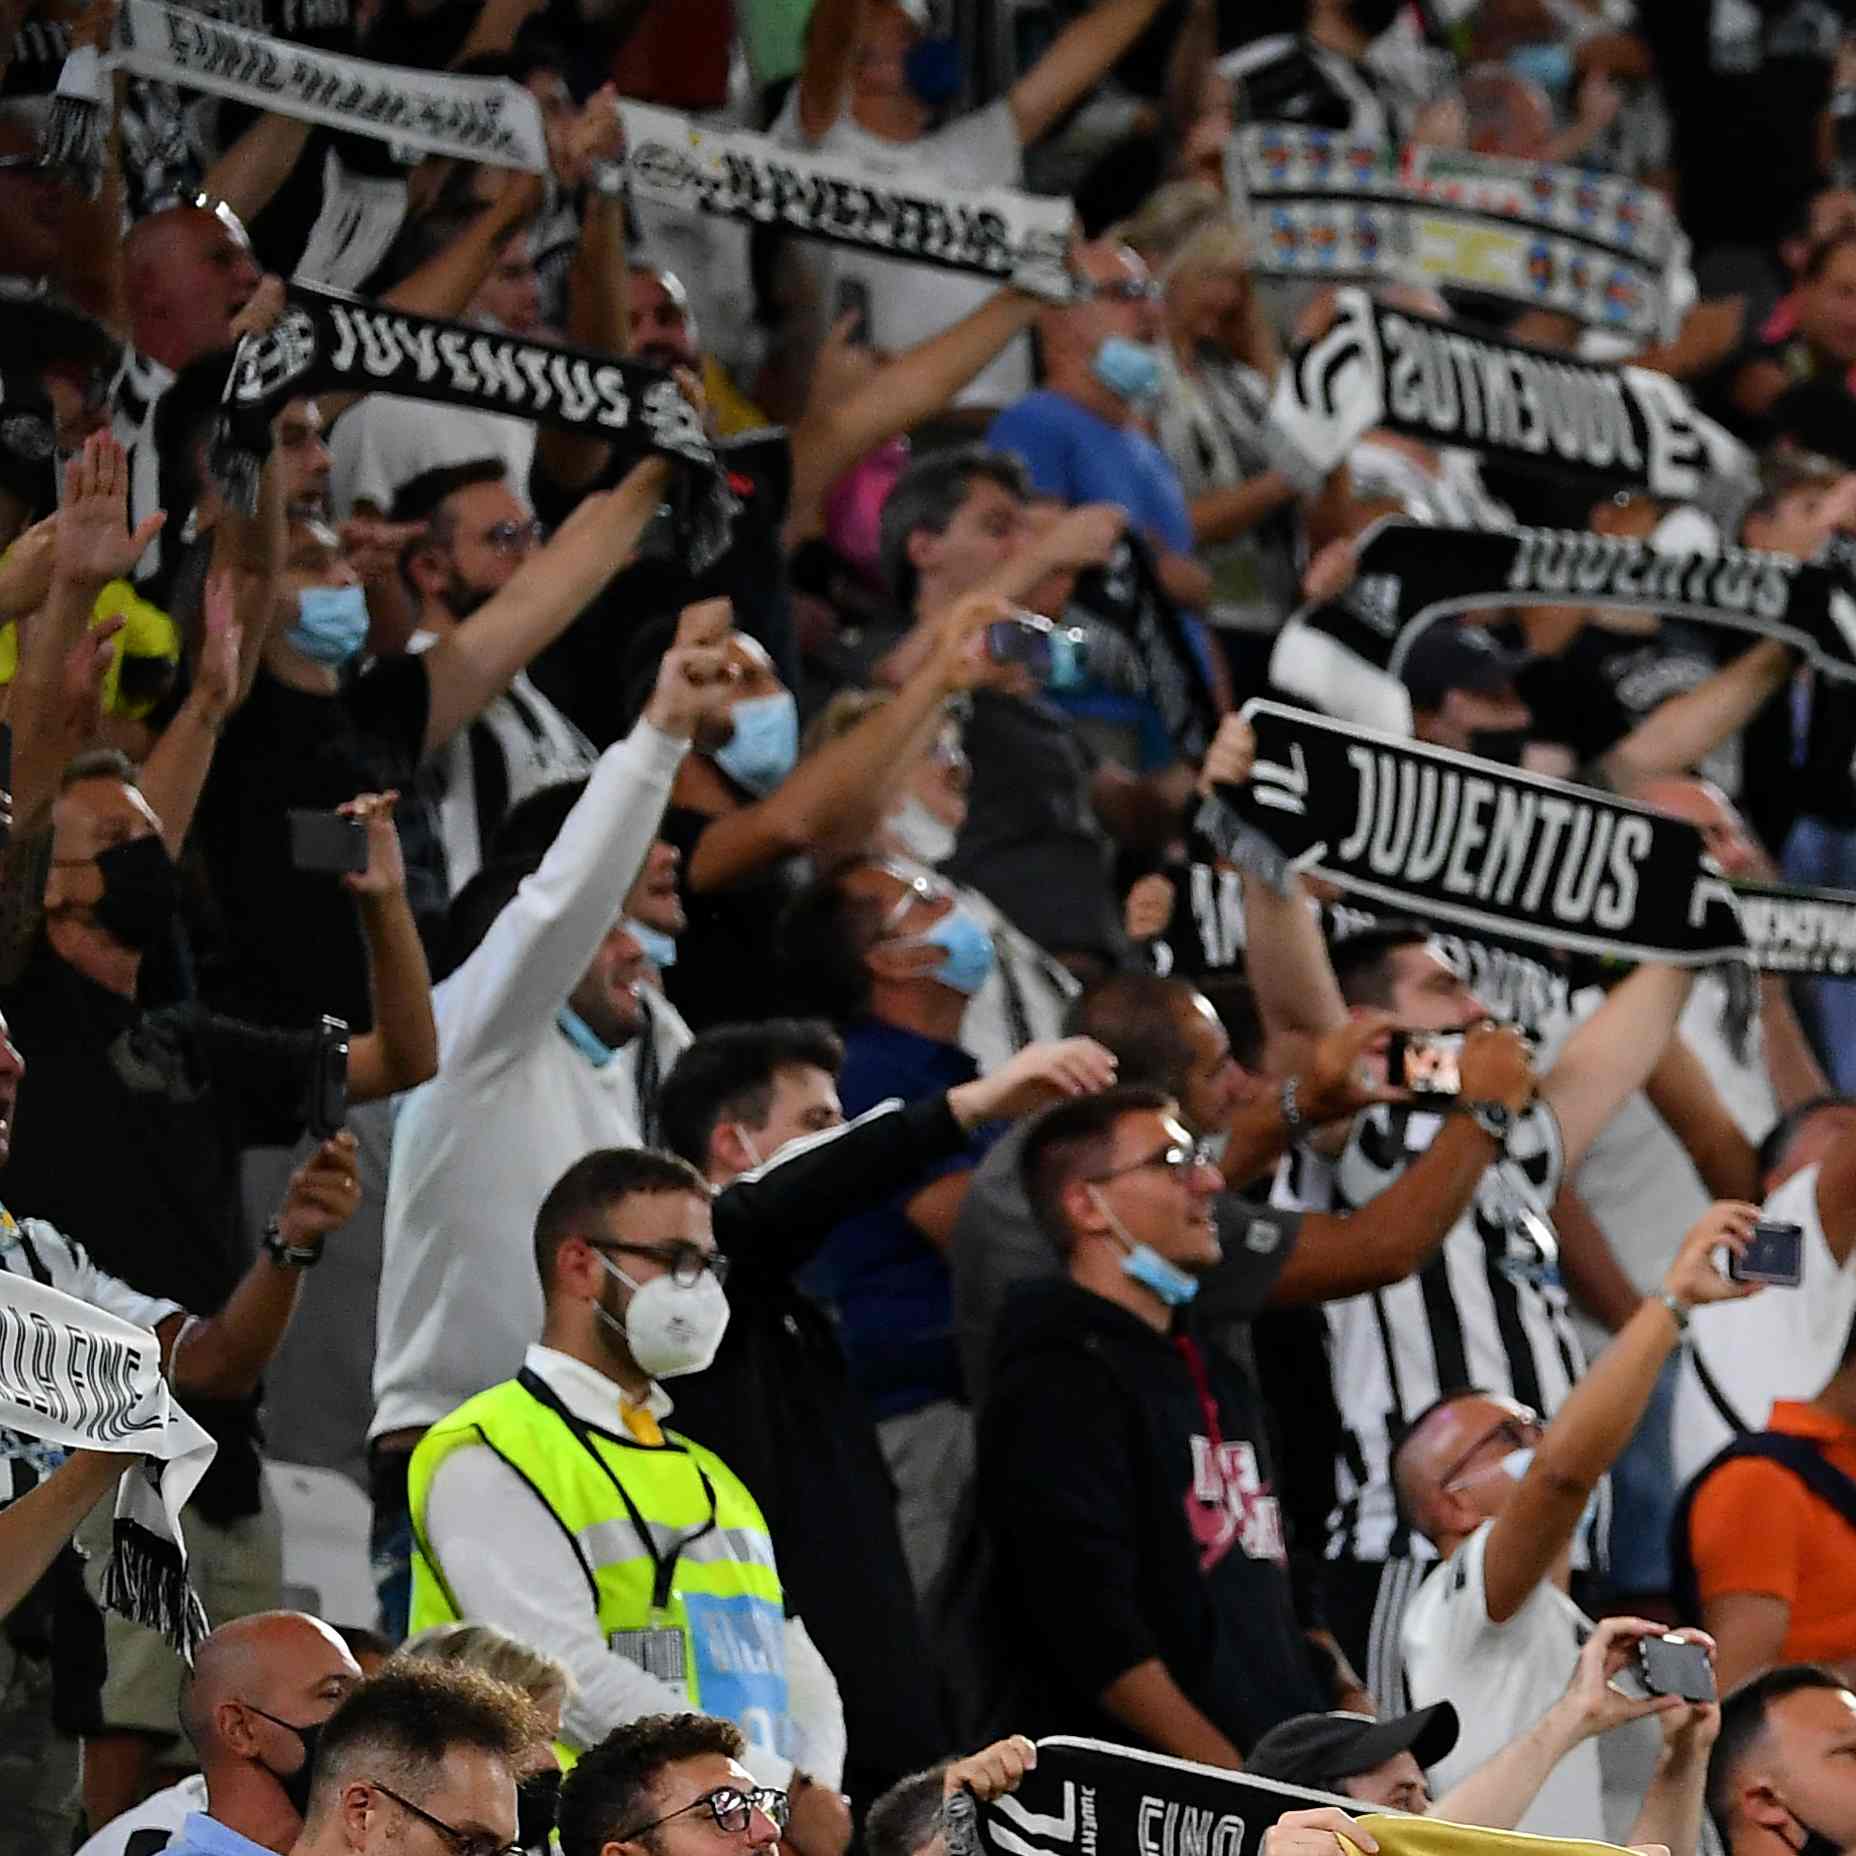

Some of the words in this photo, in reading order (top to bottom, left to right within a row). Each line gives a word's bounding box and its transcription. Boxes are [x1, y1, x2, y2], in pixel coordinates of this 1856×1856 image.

[326, 302, 630, 430] JUVENTUS
[1337, 744, 1654, 932] JUVENTUS
[64, 1322, 180, 1443] FINE
